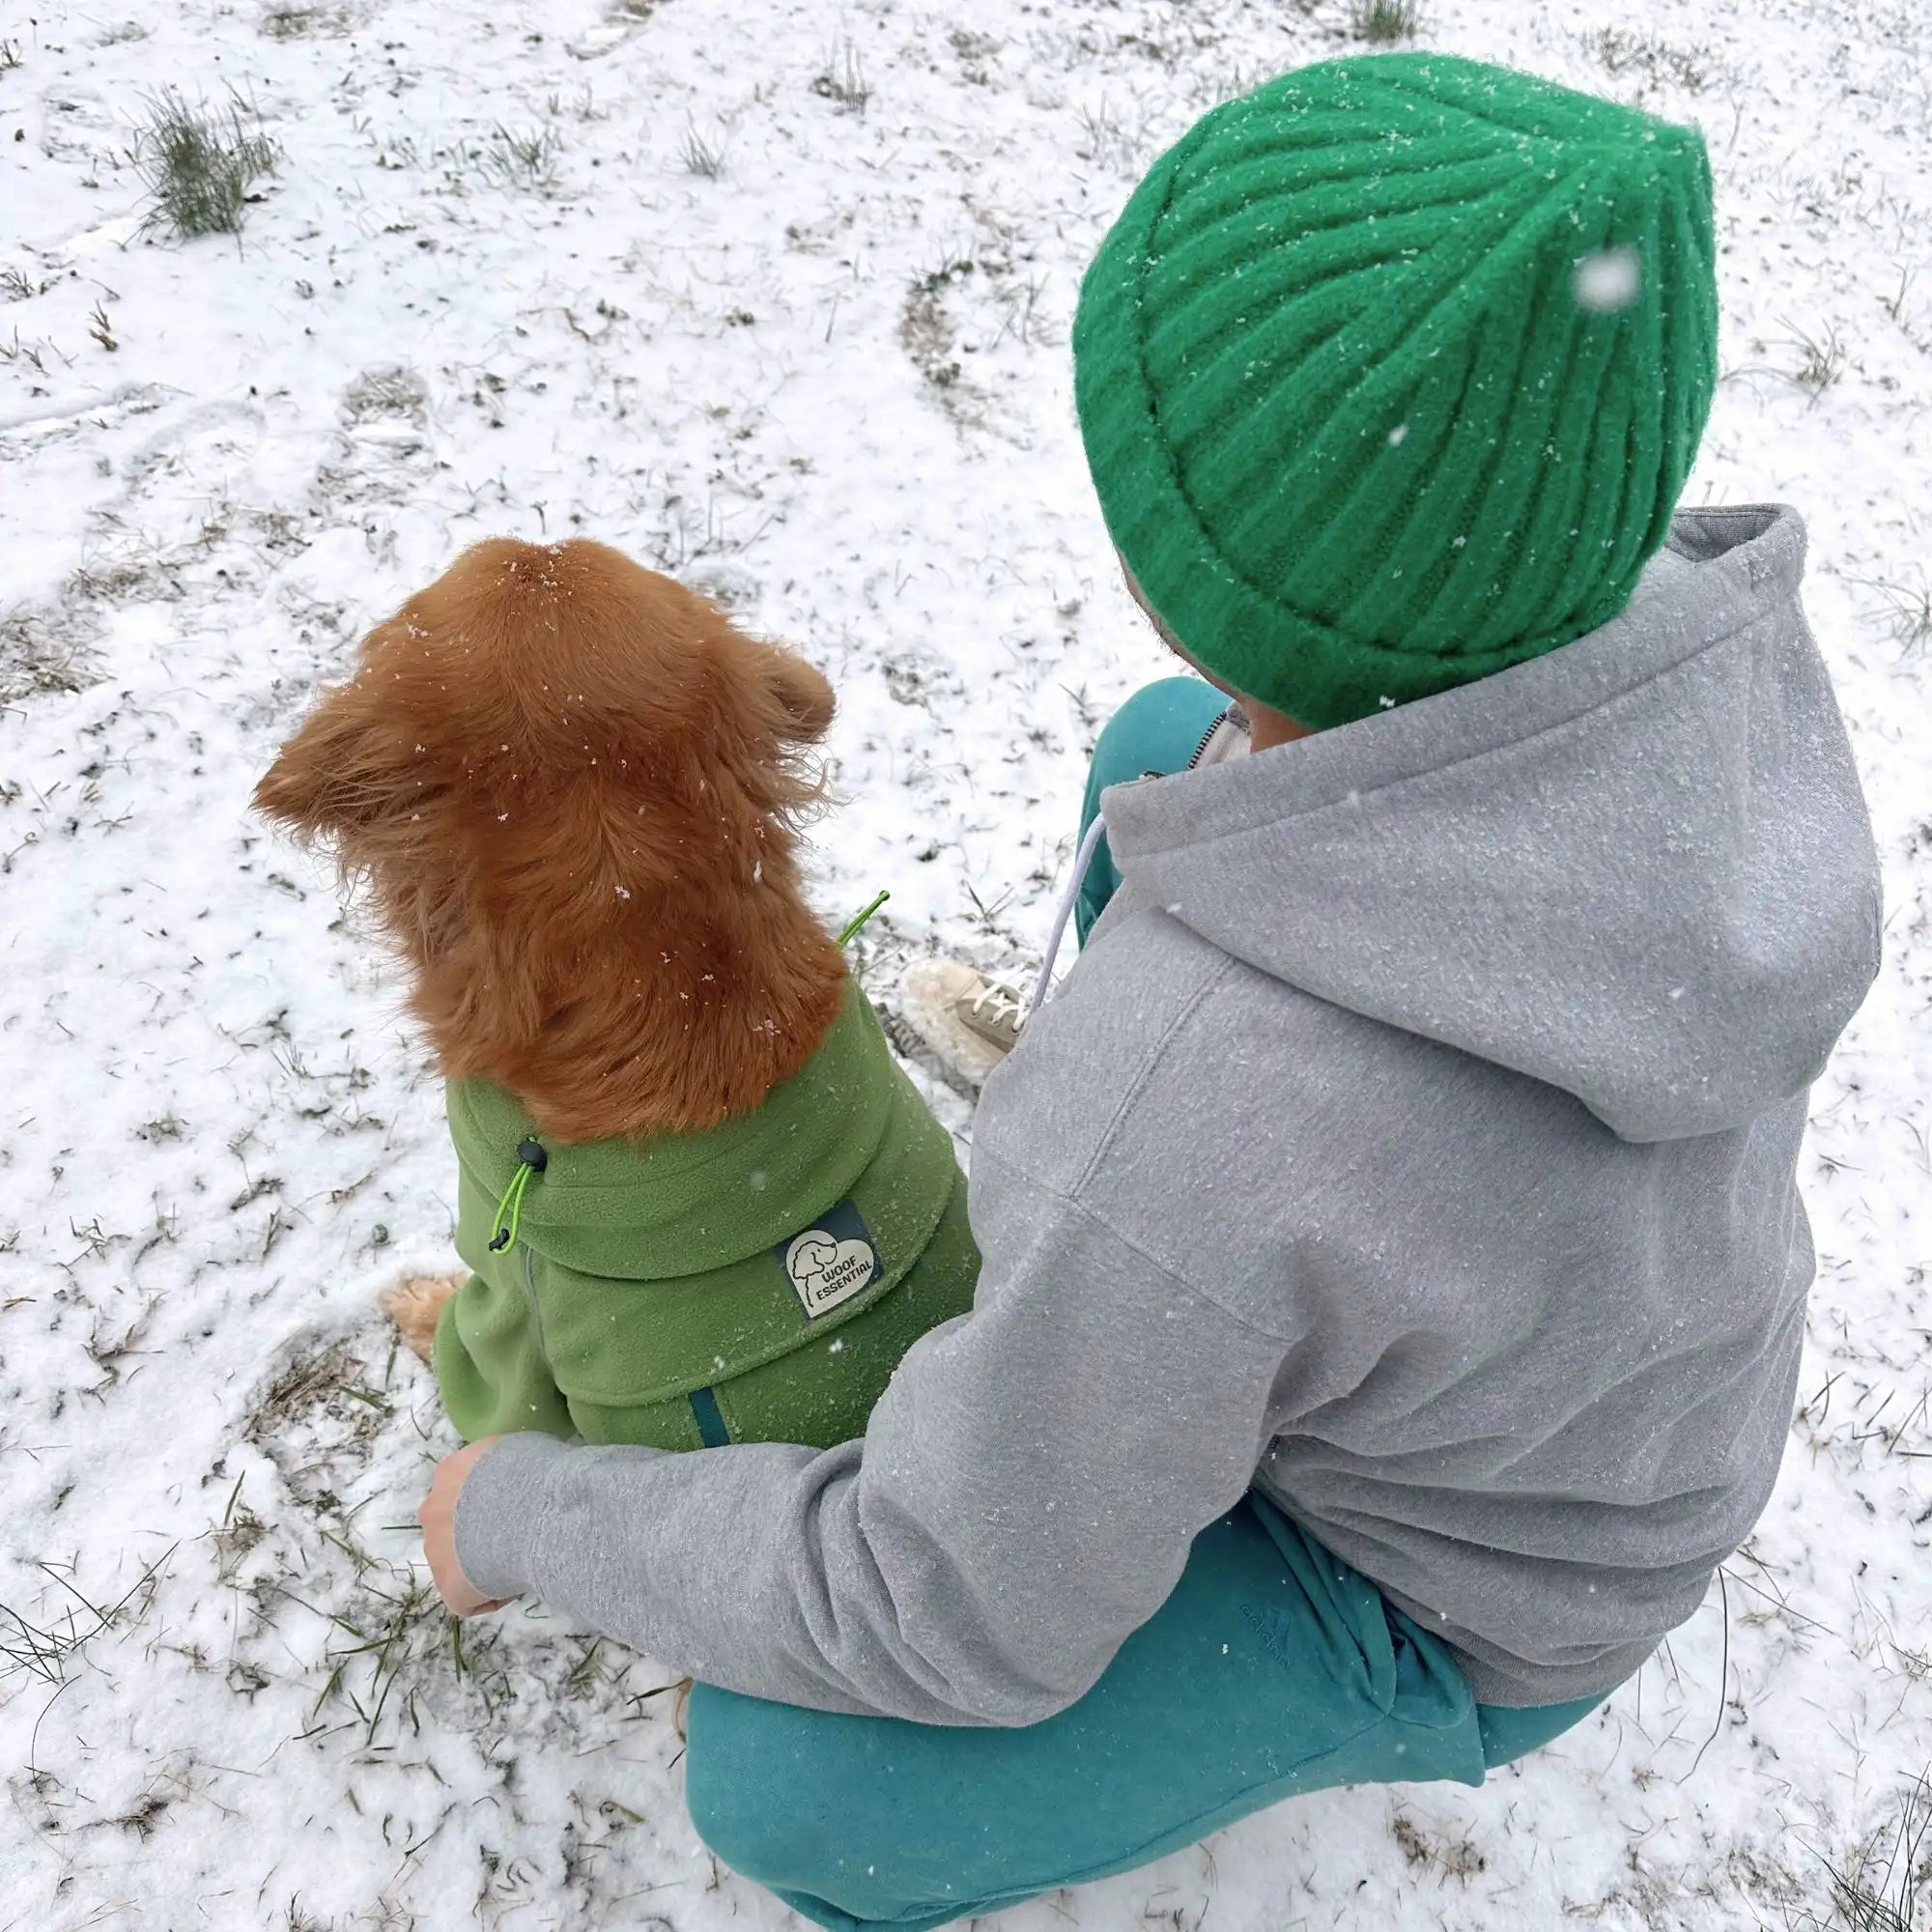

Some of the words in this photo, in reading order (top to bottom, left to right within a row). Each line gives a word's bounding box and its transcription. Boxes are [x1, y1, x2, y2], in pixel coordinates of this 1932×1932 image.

[816, 1261, 872, 1300] ESSENTIAL
[821, 1255, 857, 1283] WOOF
[1240, 1604, 1290, 1668] adidas
